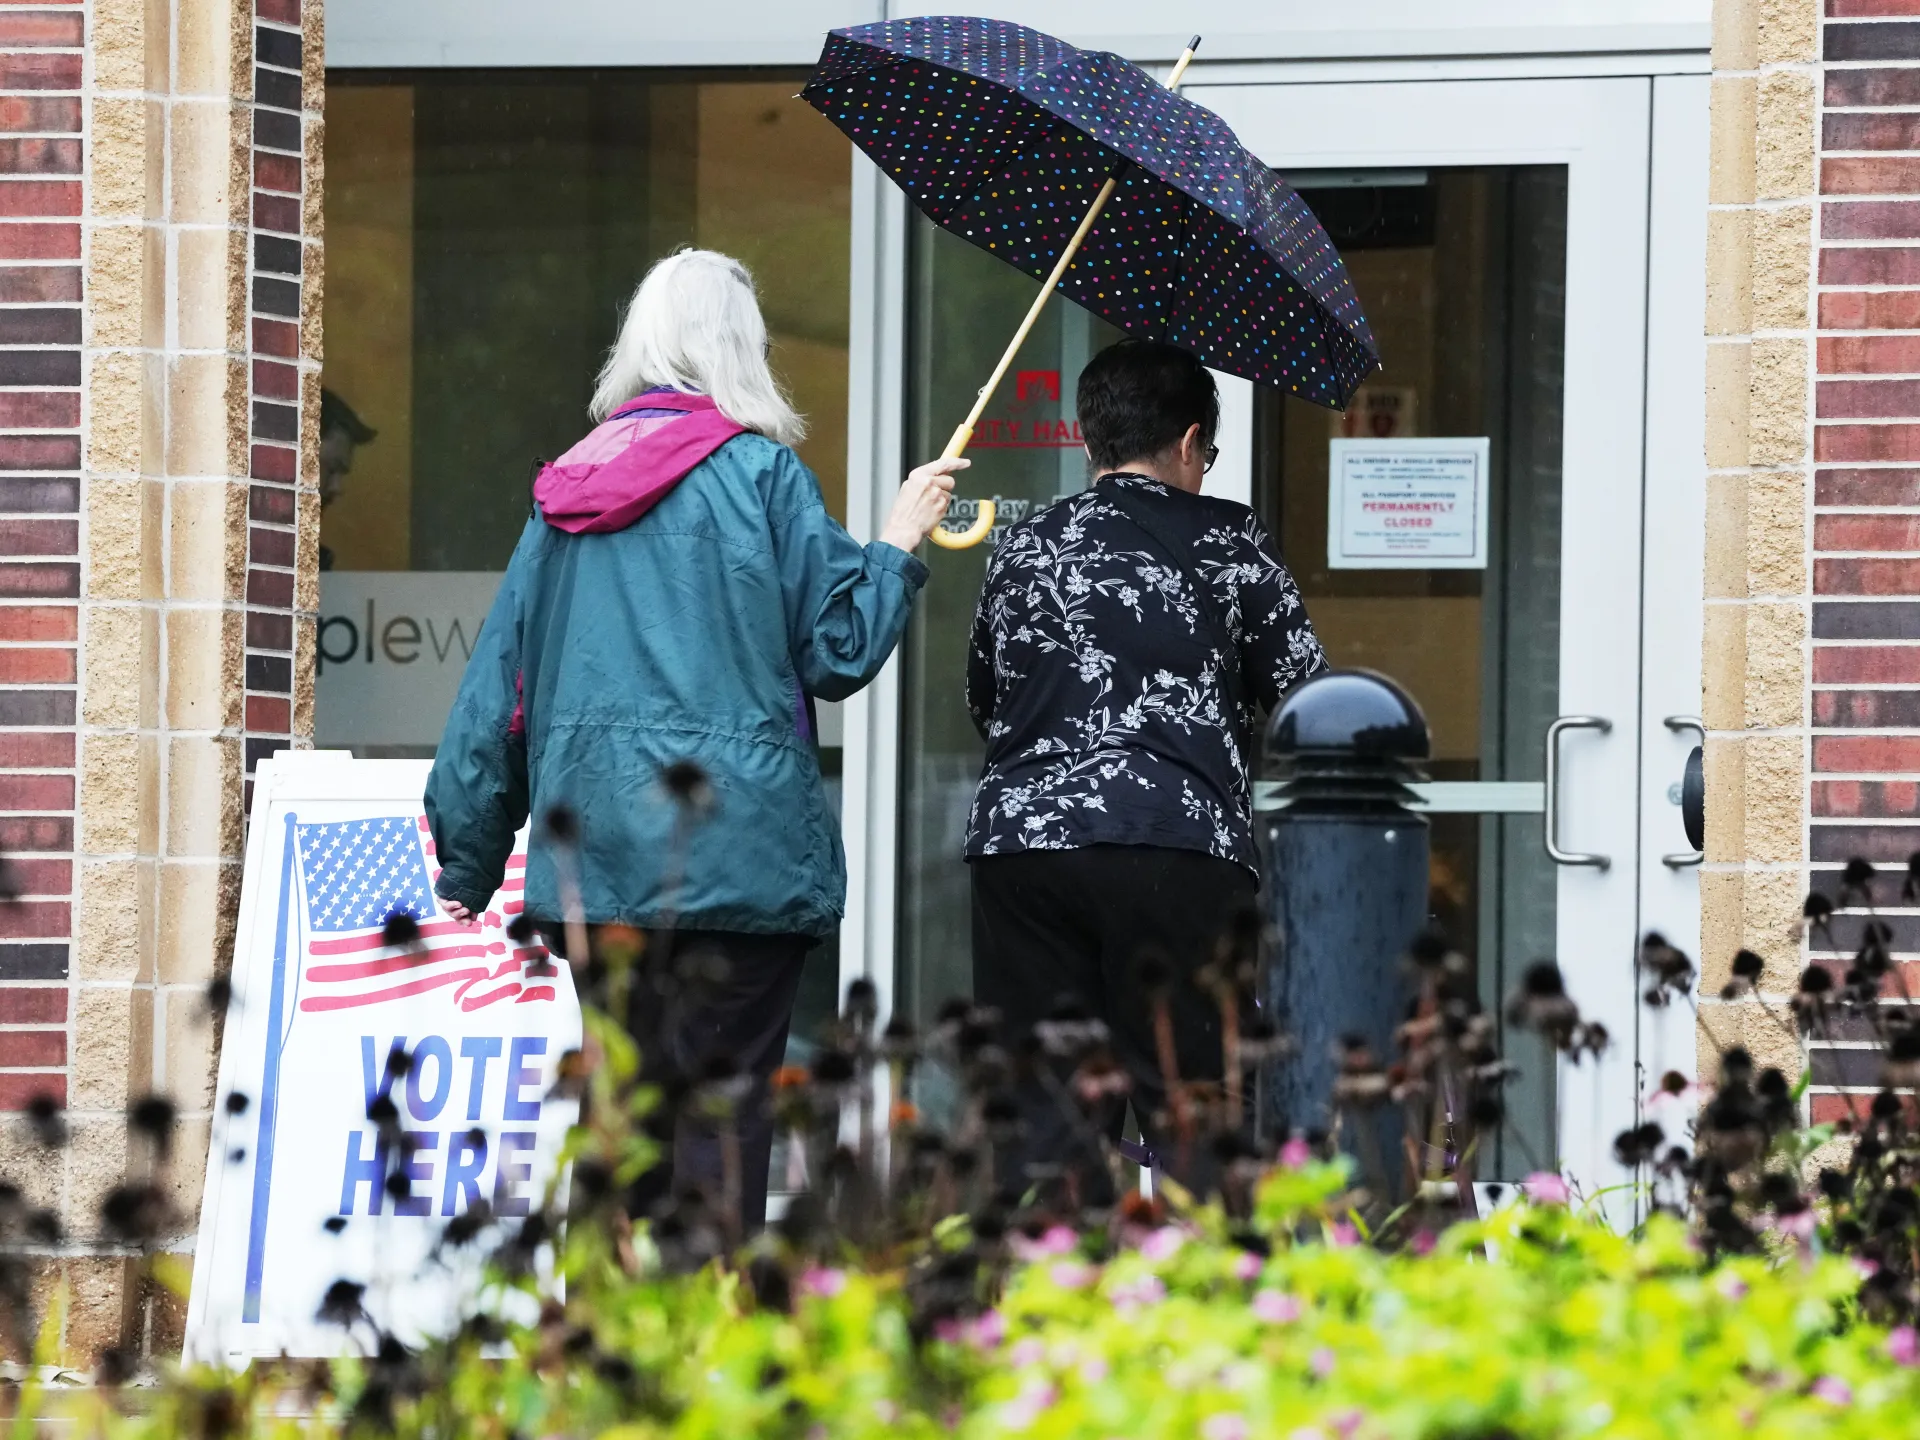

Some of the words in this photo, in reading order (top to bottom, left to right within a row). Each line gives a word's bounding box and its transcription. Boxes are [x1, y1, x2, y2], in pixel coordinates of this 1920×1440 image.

[1033, 420, 1084, 440] HAL
[1362, 502, 1455, 512] PERMANENTLY
[1384, 517, 1433, 527] CLOSED
[361, 1035, 548, 1121] VOTE
[339, 1131, 537, 1217] HERE
